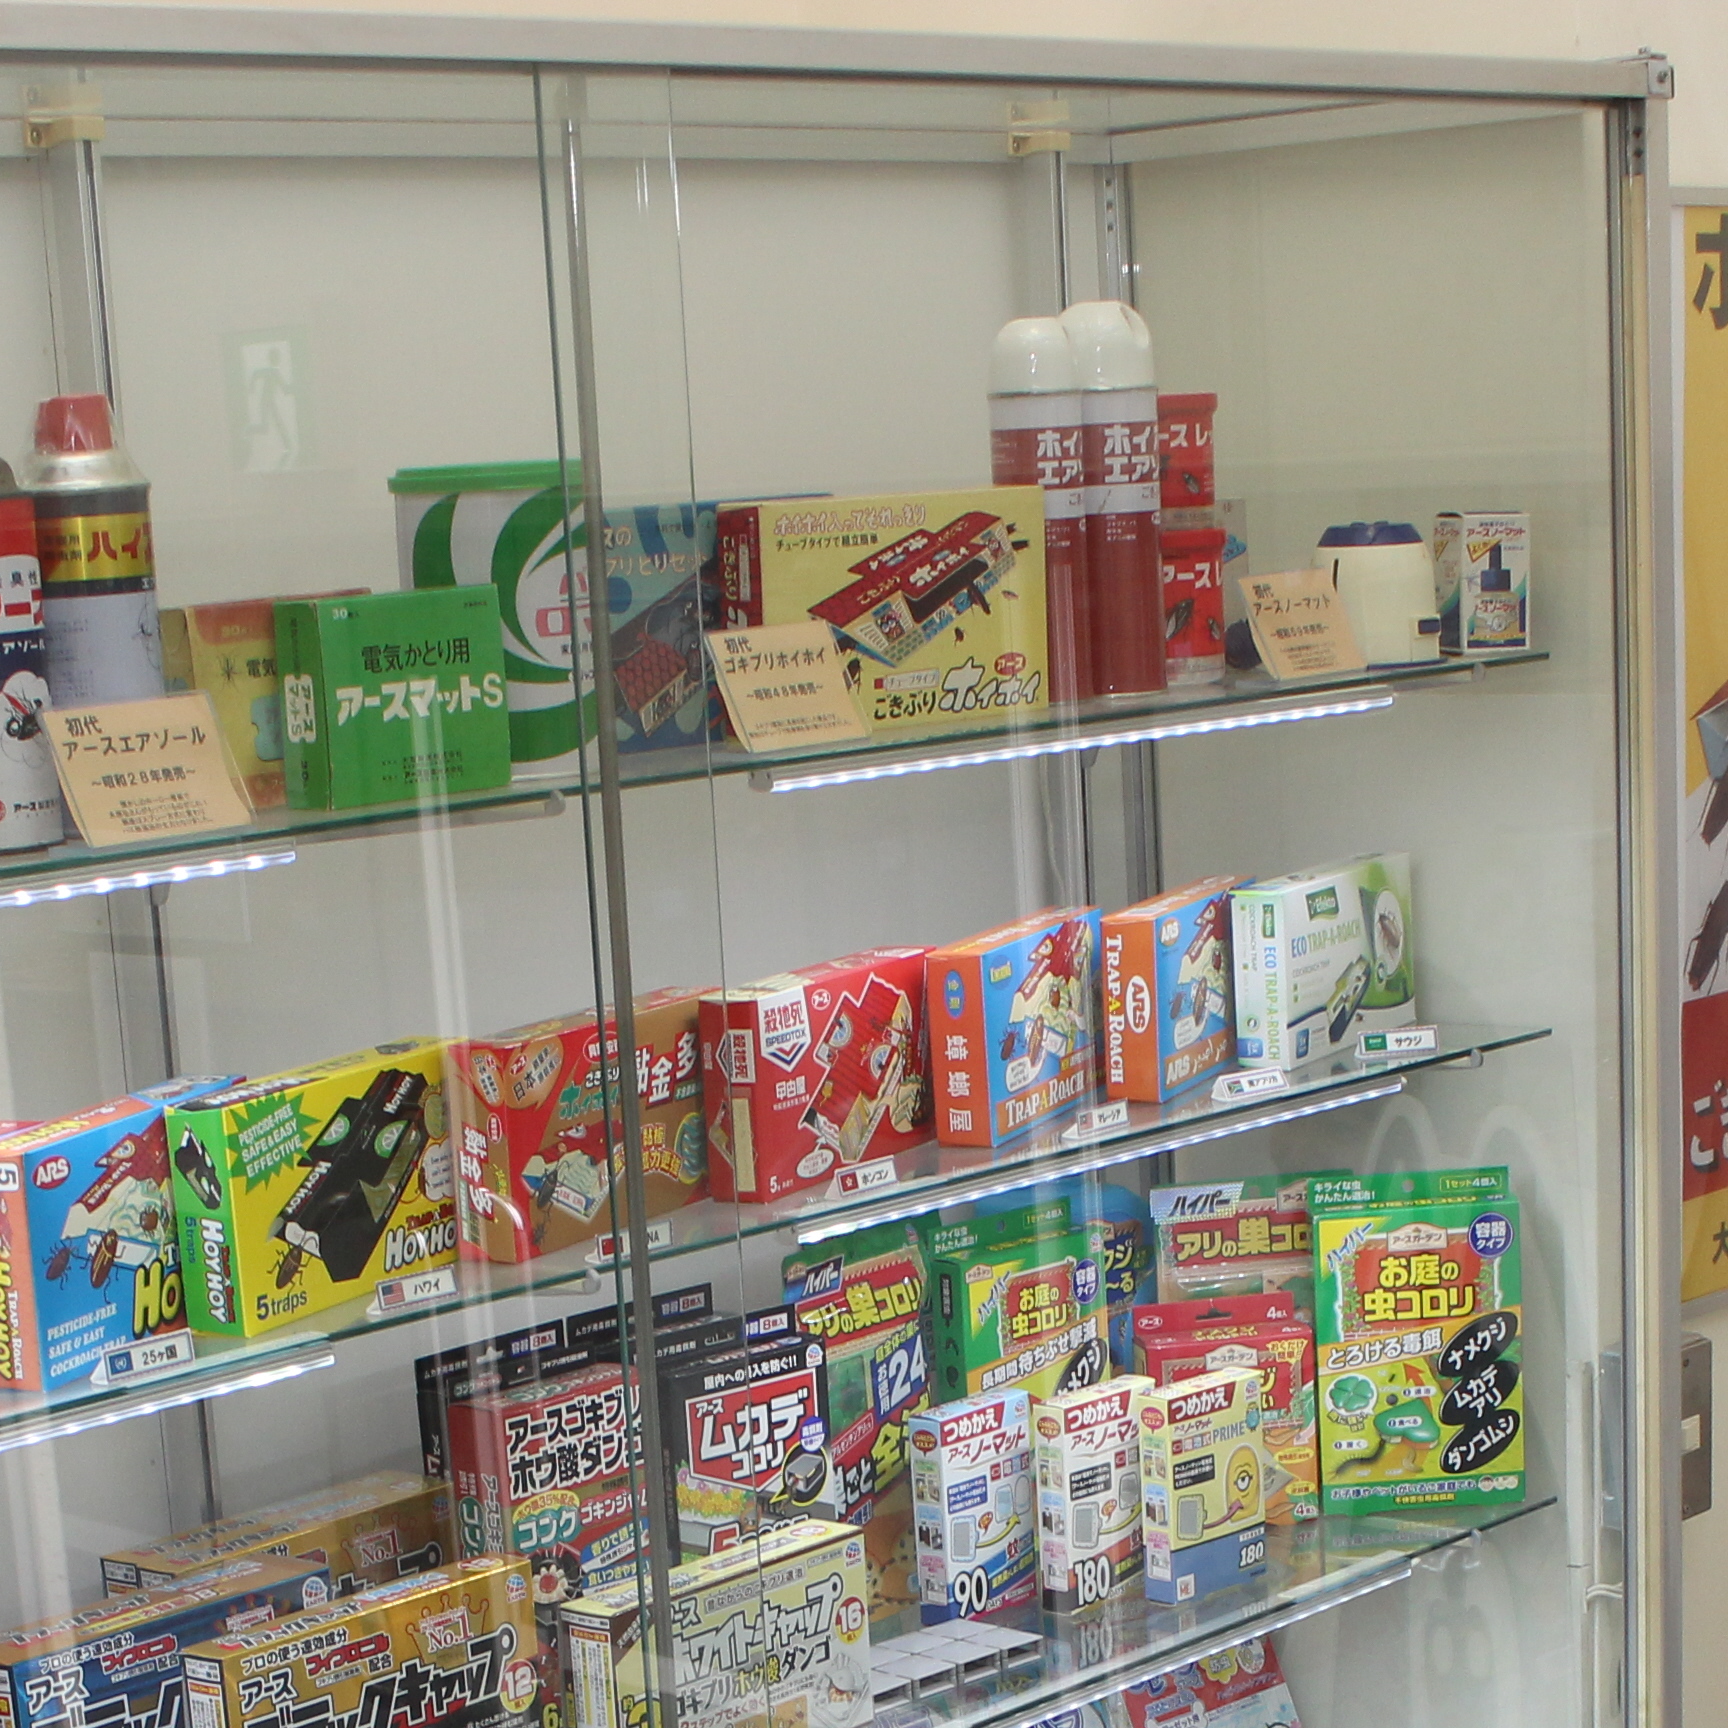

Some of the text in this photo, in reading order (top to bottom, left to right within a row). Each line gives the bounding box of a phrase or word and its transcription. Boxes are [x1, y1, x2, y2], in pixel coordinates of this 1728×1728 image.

[1252, 592, 1330, 616] アースノーマット
[361, 637, 471, 674] 電気かとり用
[722, 647, 826, 677] ゴキブリホイホイ
[723, 637, 752, 656] 初代
[335, 672, 504, 726] アースマットS
[873, 684, 938, 722] ごきぶり
[939, 657, 1040, 710] ホイホイ
[61, 725, 207, 761] アースエアゾール
[64, 715, 103, 738] 初代
[1291, 934, 1308, 959] ECO
[1394, 1034, 1423, 1048] サウジ
[237, 1103, 294, 1146] PESTICIDE-FREE
[35, 1158, 71, 1187] ARS
[245, 1134, 304, 1179] EFFECTIVE
[861, 1169, 890, 1187] ホンコン
[1313, 1181, 1362, 1193] キライな虫
[1444, 1176, 1500, 1190] 1セット4個入
[1171, 1188, 1234, 1217] ハイパー
[1476, 1222, 1506, 1239] 容器
[412, 1277, 442, 1296] ハワイ
[803, 1266, 840, 1297] ハイパー
[1378, 1254, 1459, 1287] お庭の
[255, 1288, 309, 1321] 5 traps
[1019, 1285, 1061, 1311] お庭の
[1362, 1287, 1475, 1323] 虫コロリ
[46, 1302, 118, 1342] PESTICIDE-FREE
[1012, 1303, 1069, 1340] 虫コロリ
[1327, 1326, 1443, 1371] とろける毒餌
[1447, 1317, 1508, 1372] ナメクジ
[887, 1334, 927, 1397] 24
[1066, 1395, 1124, 1430] つめかえ
[1172, 1387, 1230, 1421] つめかえ
[700, 1387, 812, 1462] ムカデ
[942, 1406, 1000, 1444] つめかえ
[1211, 1421, 1246, 1445] PRIME
[730, 1439, 785, 1479] コロリ
[1445, 1414, 1516, 1471] ダンゴムシ
[518, 1512, 577, 1550] コンク
[1239, 1541, 1265, 1569] 180
[953, 1567, 989, 1618] 90
[1073, 1557, 1111, 1607] 180
[425, 1615, 475, 1652] No.1
[838, 1606, 862, 1634] 16
[241, 1628, 349, 1674] プロの使う速効成分
[238, 1668, 298, 1715] アース
[504, 1668, 534, 1696] 12
